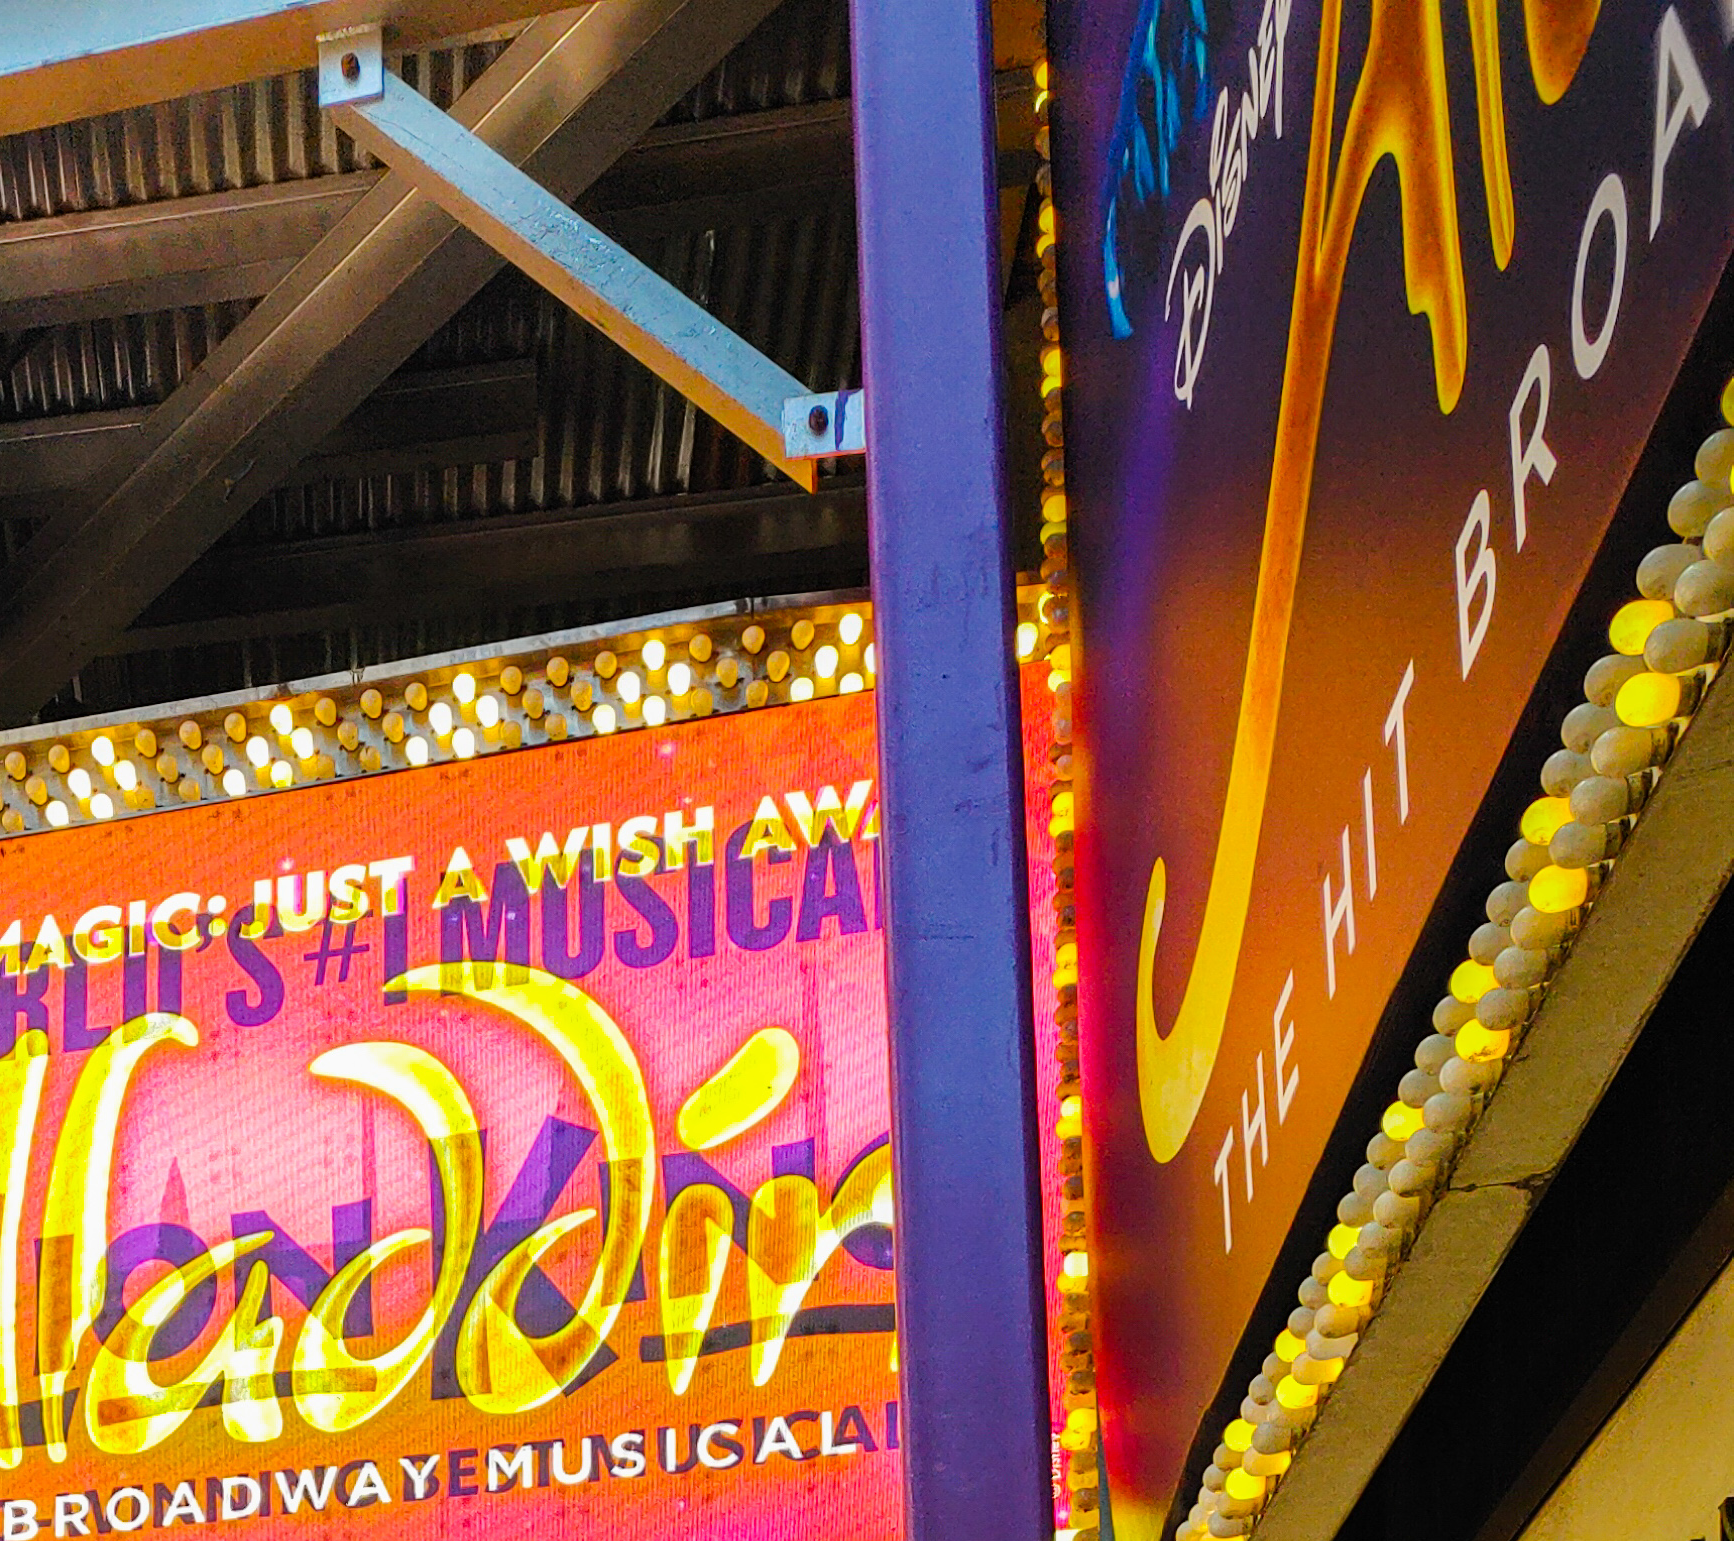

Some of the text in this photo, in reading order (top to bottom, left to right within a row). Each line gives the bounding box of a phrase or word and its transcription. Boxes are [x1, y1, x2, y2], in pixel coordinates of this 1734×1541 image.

[1214, 0, 1734, 1256] THE HIT BROA
[240, 854, 417, 940] JUST
[432, 846, 488, 910] A
[505, 805, 715, 895] WISH
[739, 779, 881, 861] AW
[486, 1410, 858, 1491] MUSICAL
